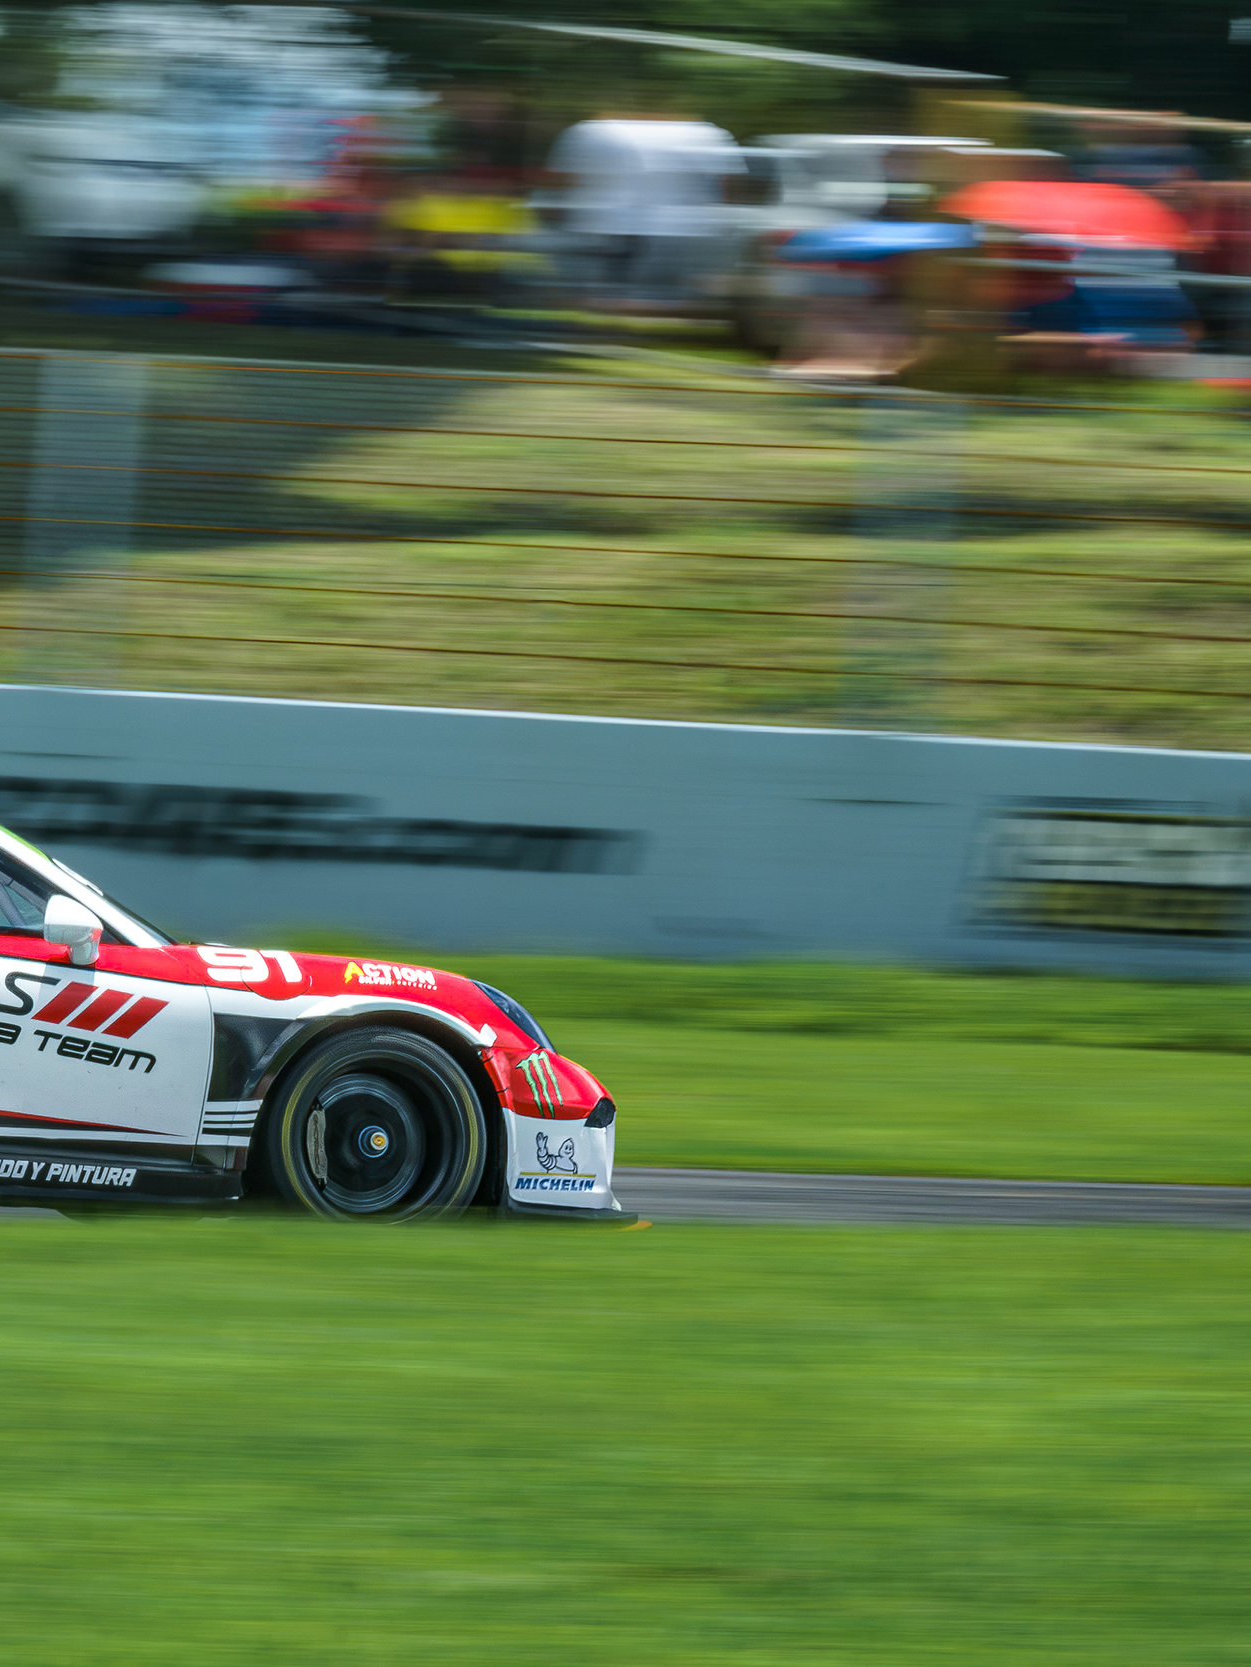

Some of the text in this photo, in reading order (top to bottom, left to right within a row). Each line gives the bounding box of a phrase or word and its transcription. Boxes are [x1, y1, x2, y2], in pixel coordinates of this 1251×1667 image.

[196, 946, 303, 983] 91
[344, 961, 436, 986] ACTION
[31, 1161, 46, 1181] Y
[46, 1163, 138, 1187] PINTURA
[515, 1177, 595, 1192] MICHELIN
